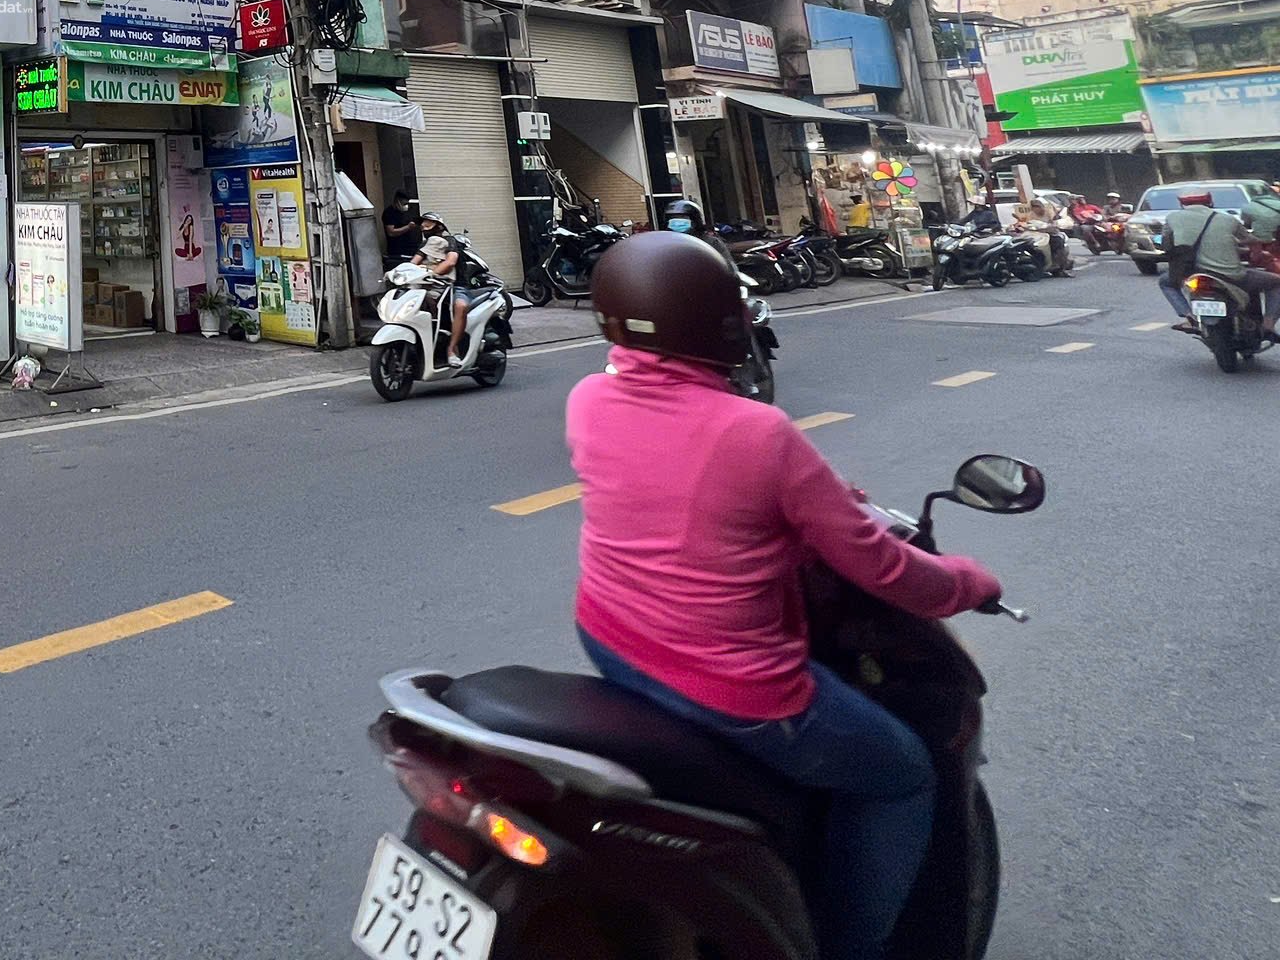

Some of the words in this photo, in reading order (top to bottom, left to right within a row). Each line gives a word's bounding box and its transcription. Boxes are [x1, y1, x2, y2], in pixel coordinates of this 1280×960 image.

[110, 29, 126, 39] NHÀ
[127, 30, 154, 41] THUỐC
[698, 24, 742, 50] ASUS
[110, 49, 127, 60] KIM
[129, 50, 156, 61] CHÂU
[33, 83, 57, 109] CHÂU
[90, 79, 122, 100] KIM
[128, 79, 175, 102] CHÂU
[1031, 92, 1068, 105] PHÁT
[1073, 90, 1105, 102] HUY
[261, 167, 296, 177] VitaHealth
[16, 208, 29, 220] NHÀ
[30, 206, 53, 221] THUỐC
[53, 207, 65, 220] TÂY
[19, 225, 35, 240] KIM
[37, 223, 63, 241] CHÂU
